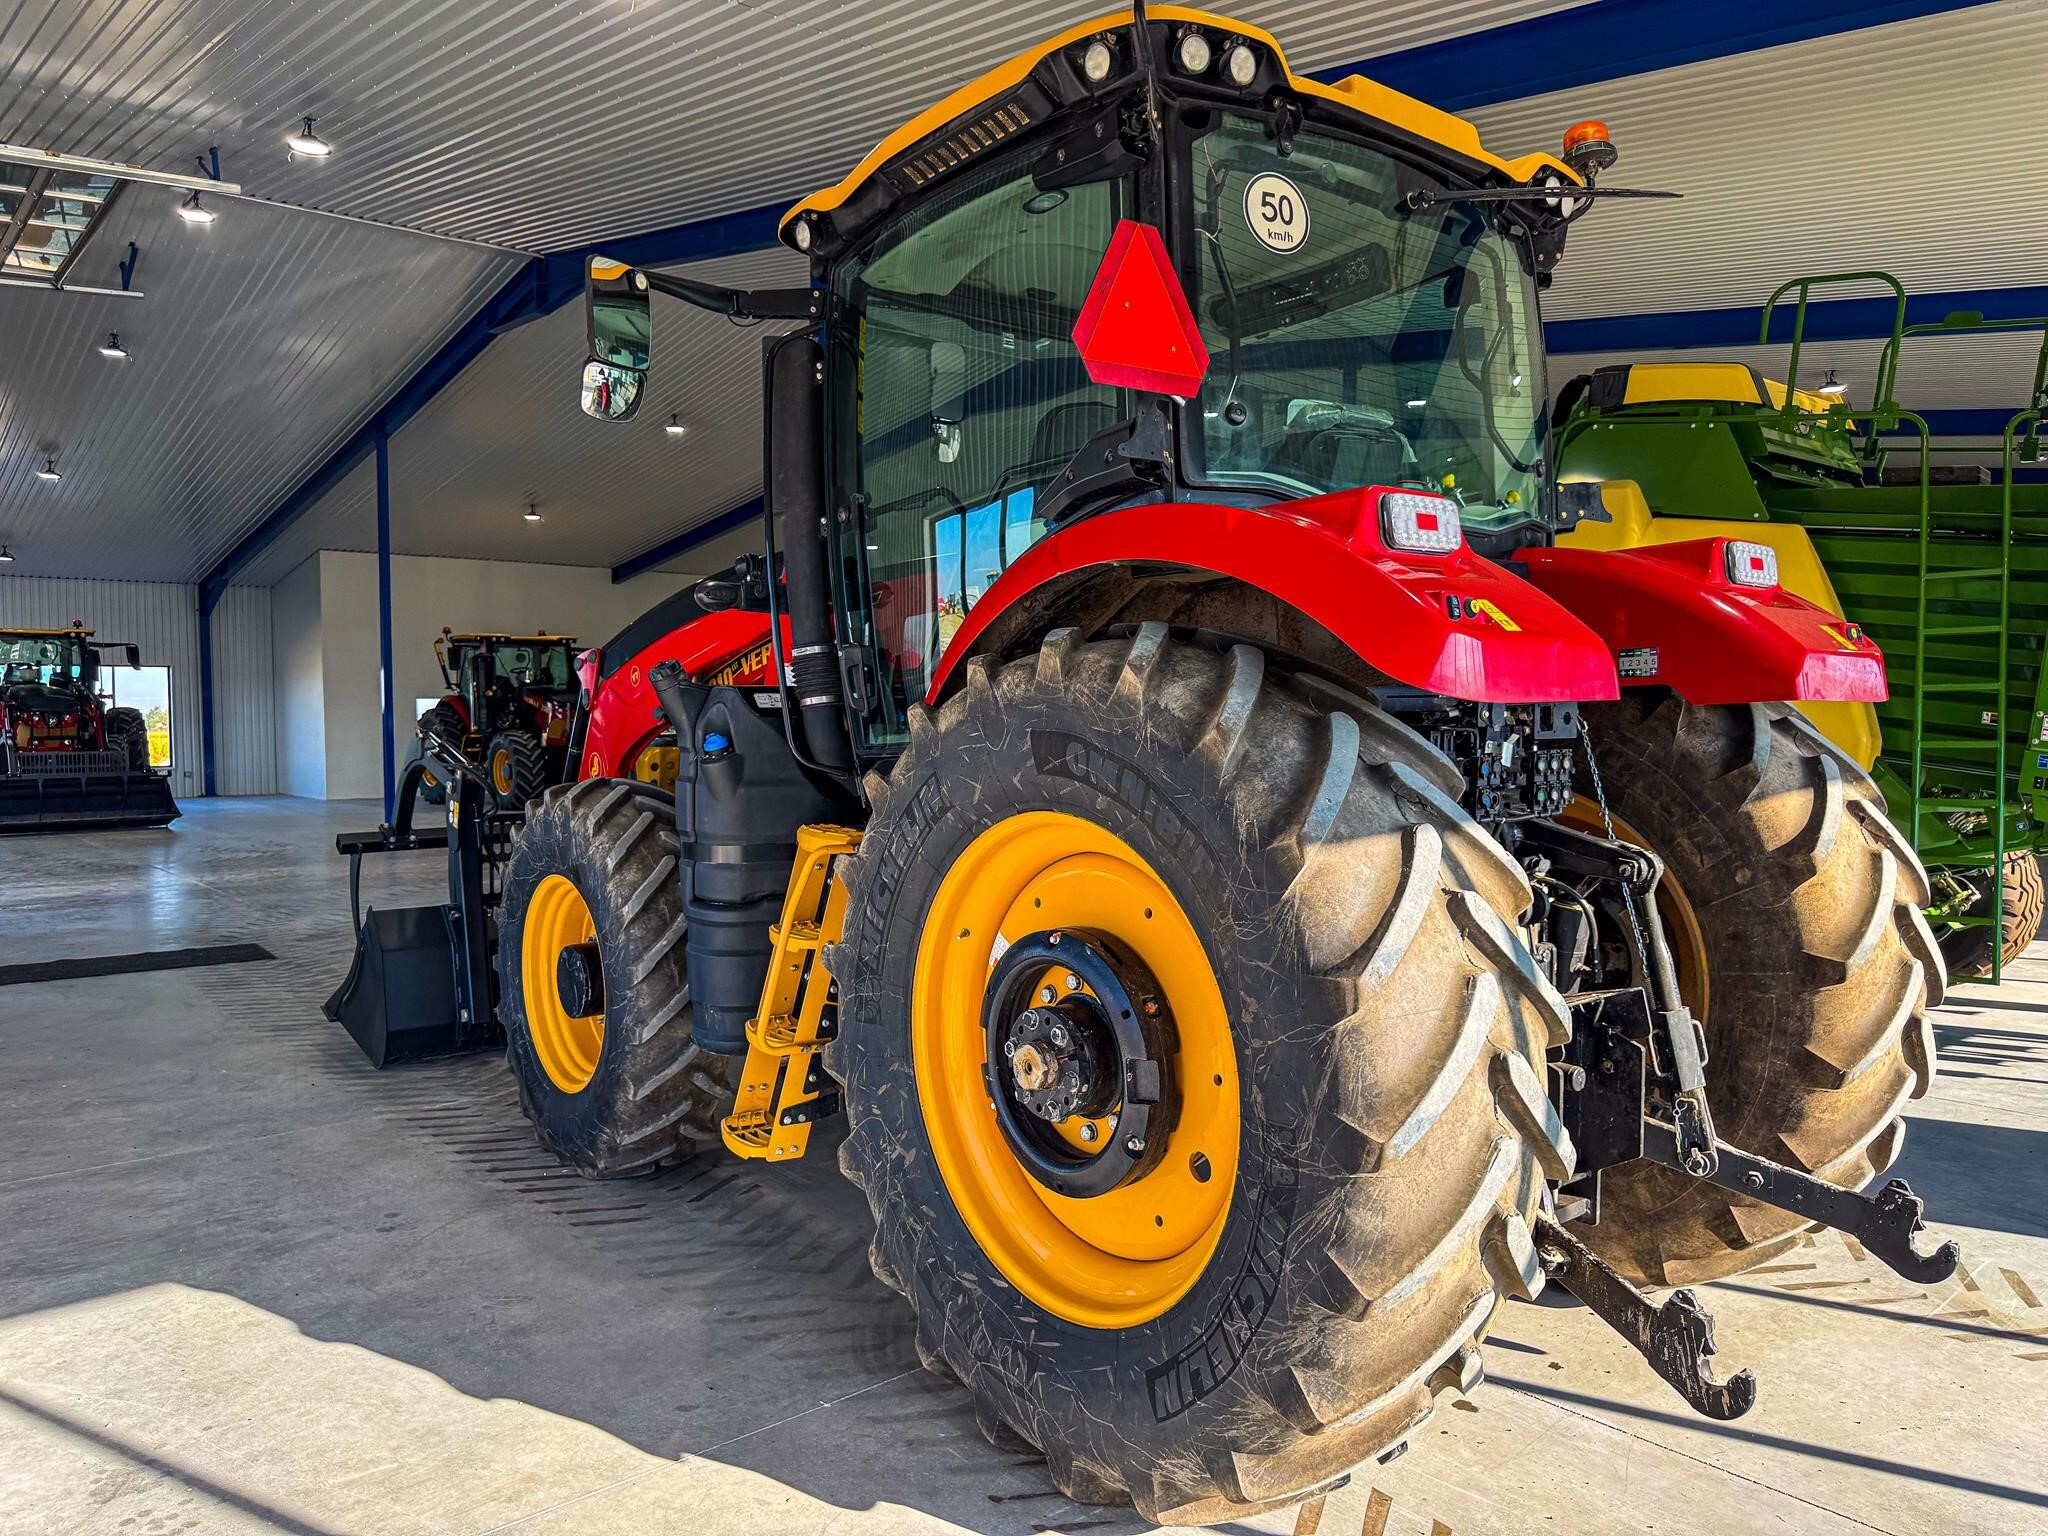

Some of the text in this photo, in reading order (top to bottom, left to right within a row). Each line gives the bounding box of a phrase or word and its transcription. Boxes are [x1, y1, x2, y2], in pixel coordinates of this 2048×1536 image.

[1261, 191, 1294, 226] 50
[1267, 228, 1294, 243] km/h
[858, 773, 950, 975] MICHELIN
[1153, 1196, 1290, 1419] MICHELIN
